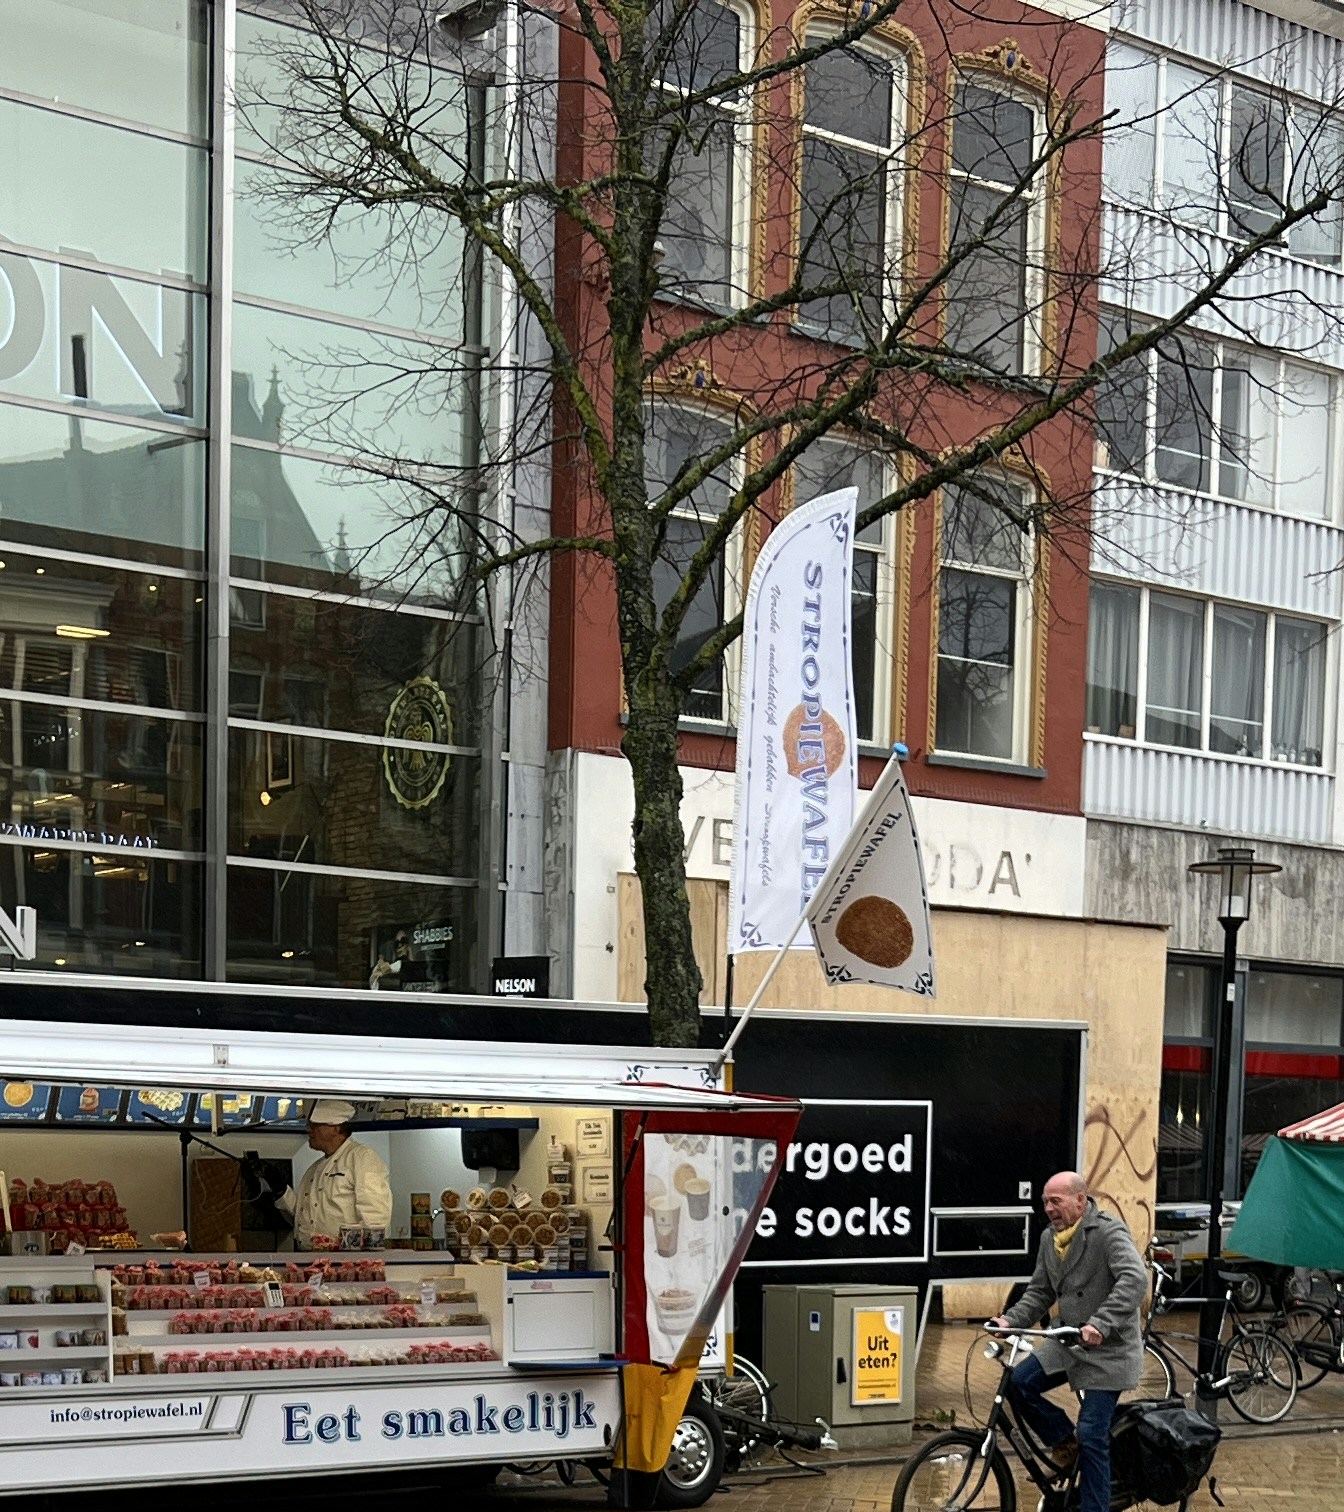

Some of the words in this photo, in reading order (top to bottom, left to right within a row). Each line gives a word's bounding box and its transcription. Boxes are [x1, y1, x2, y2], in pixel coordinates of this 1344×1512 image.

[495, 978, 536, 993] NELSON
[795, 1197, 911, 1237] socks
[867, 1335, 890, 1351] Uit
[858, 1352, 898, 1369] eten?
[50, 1402, 203, 1424] info@stropiewafel.nl
[282, 1402, 361, 1444] Eet
[381, 1388, 598, 1439] smakelijk
